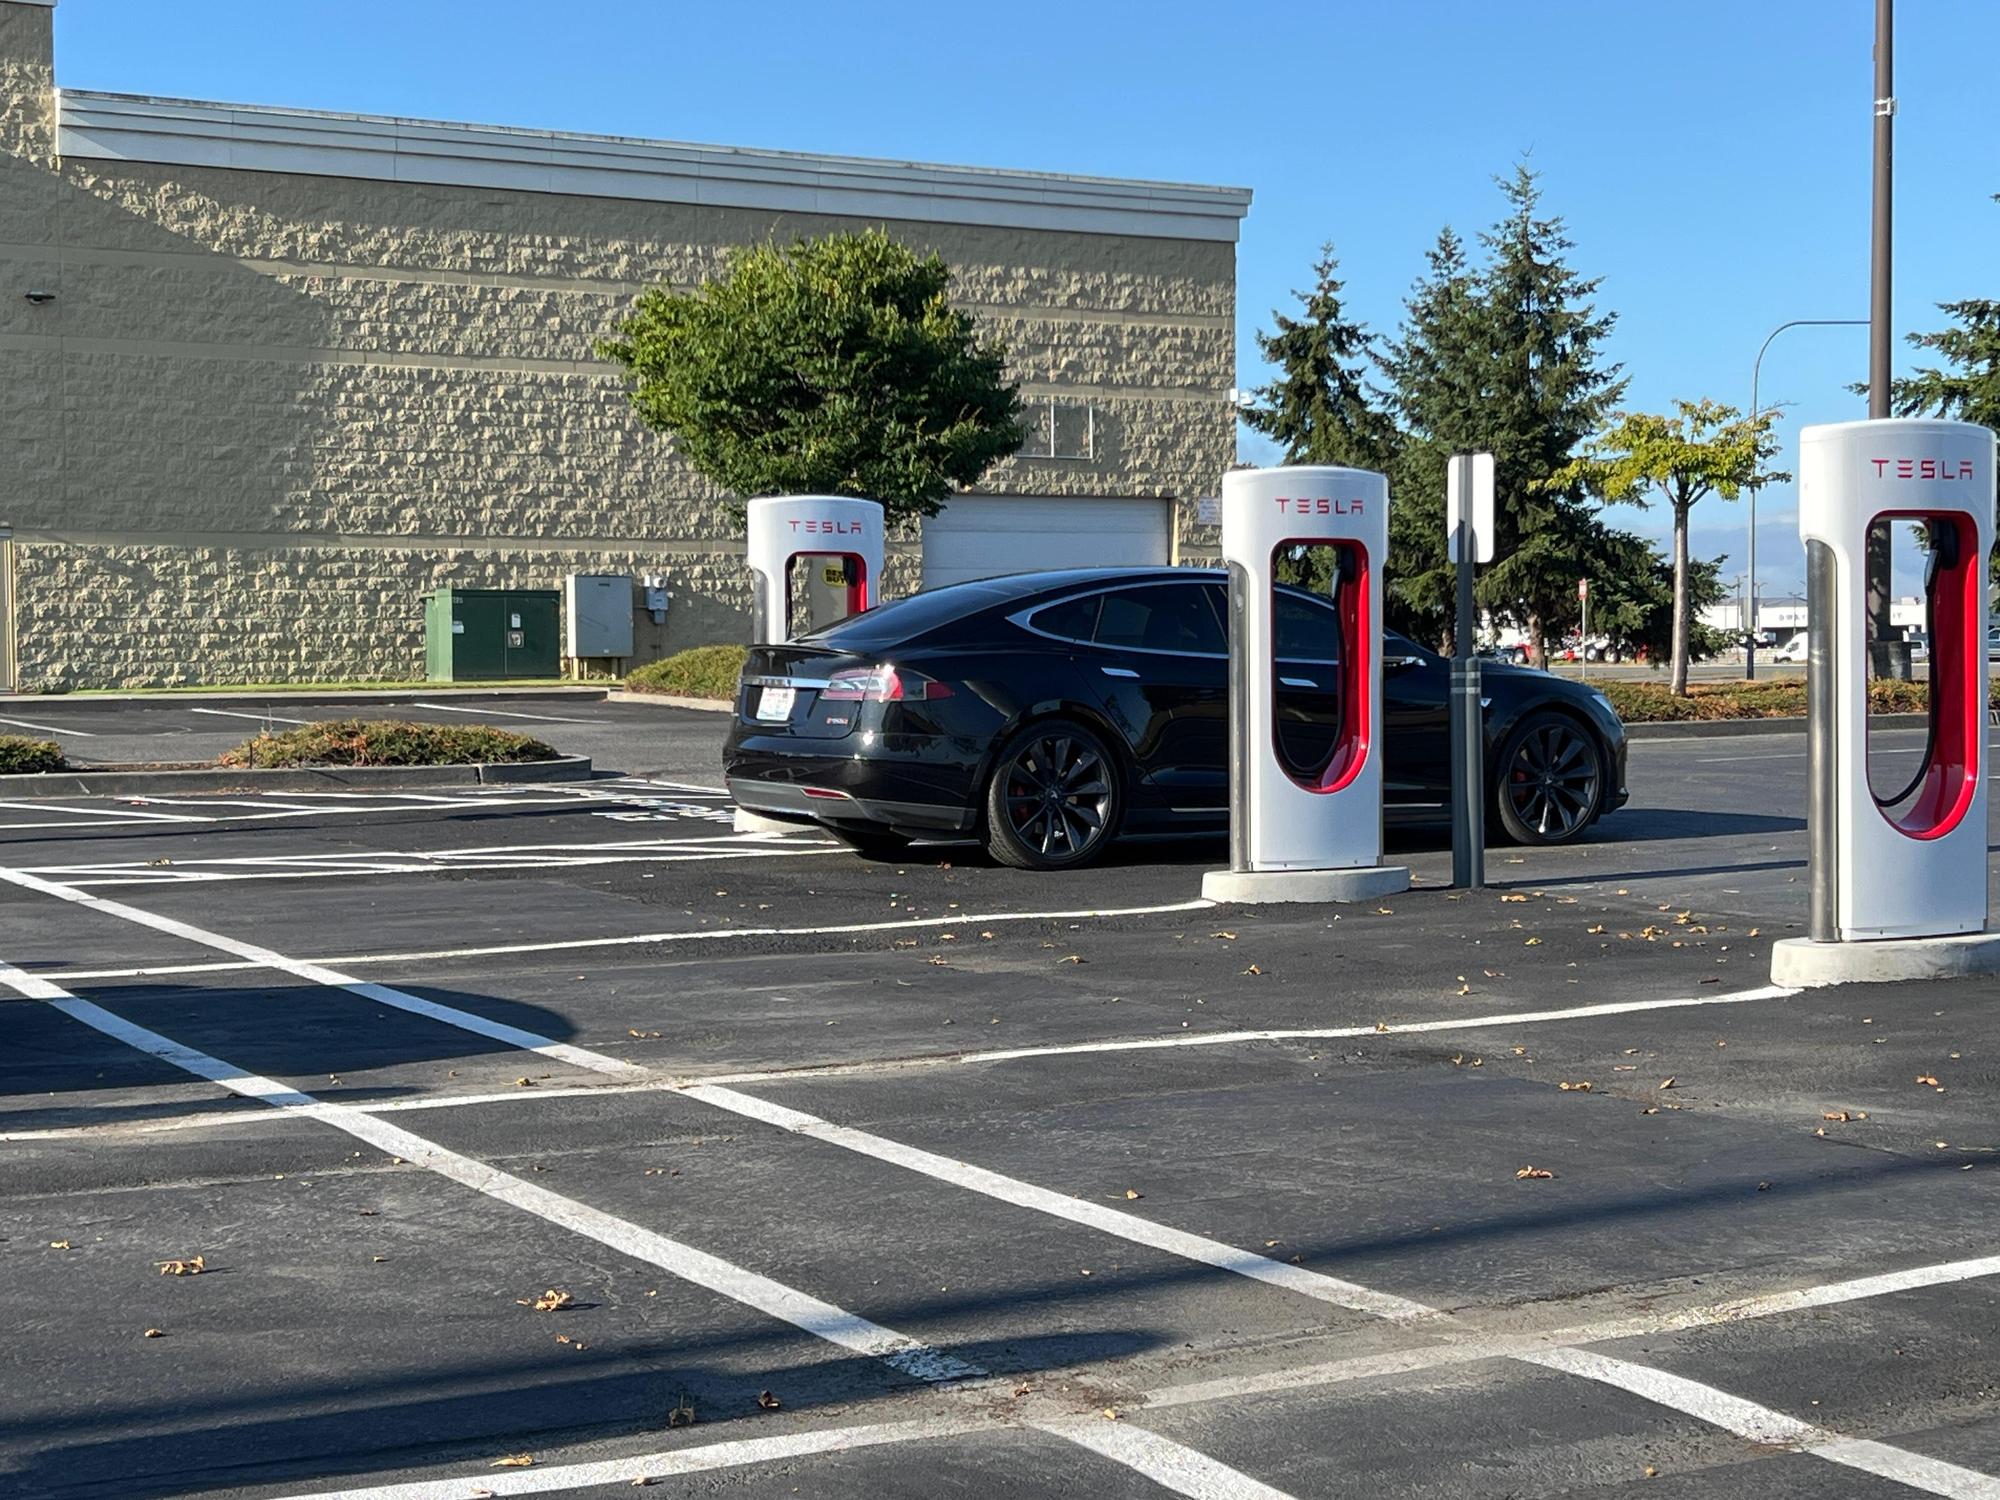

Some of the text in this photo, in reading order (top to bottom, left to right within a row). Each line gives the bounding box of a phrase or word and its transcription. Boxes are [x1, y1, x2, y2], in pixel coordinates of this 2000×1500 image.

[1871, 459, 1973, 480] TESLA
[1275, 498, 1364, 514] TESLA
[788, 520, 862, 534] TESLA
[826, 576, 846, 584] BUY
